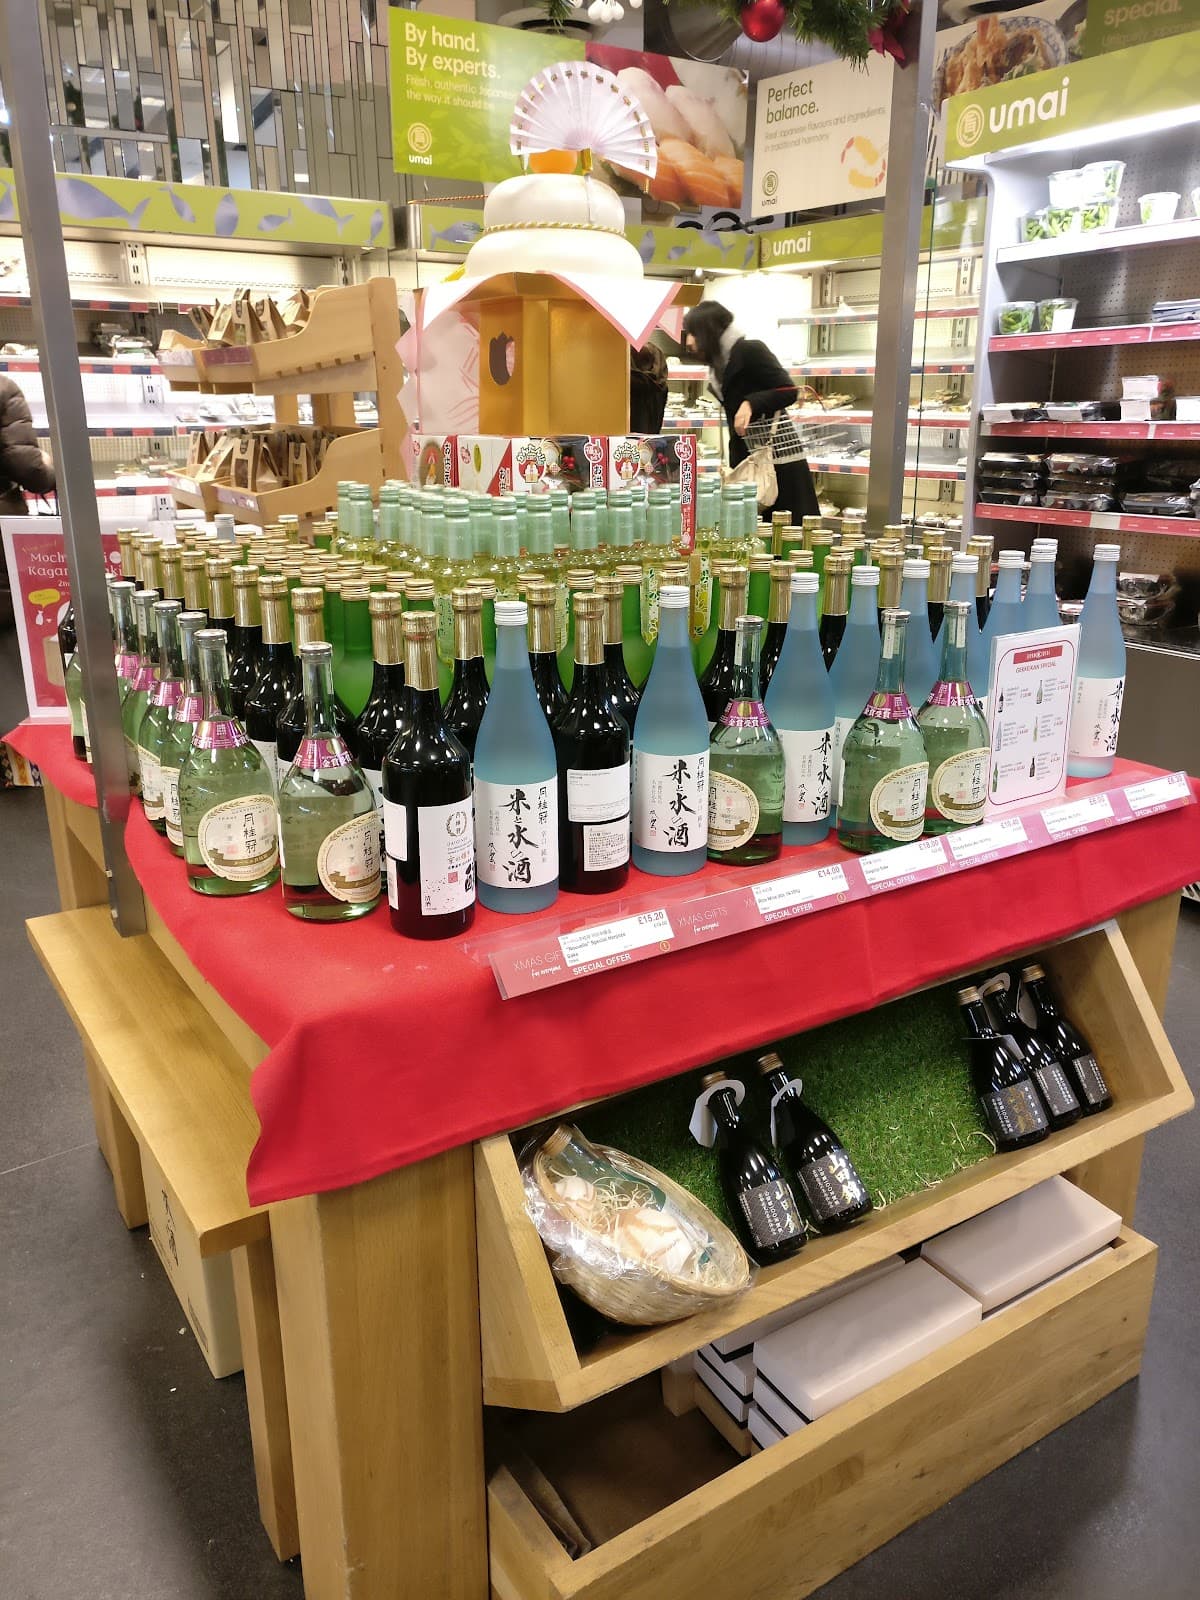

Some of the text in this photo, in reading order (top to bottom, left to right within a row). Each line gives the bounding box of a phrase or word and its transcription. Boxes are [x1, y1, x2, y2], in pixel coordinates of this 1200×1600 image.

[405, 22, 480, 53] By hand.
[405, 46, 501, 79] By experts.
[435, 78, 477, 94] authentic
[767, 80, 814, 104] Perfect
[406, 89, 421, 101] the
[423, 93, 442, 105] way
[443, 95, 450, 105] it
[988, 76, 1070, 134] umai
[766, 101, 819, 125] balance.
[408, 152, 433, 166] umai
[761, 196, 778, 207] umai
[773, 231, 811, 257] umai
[663, 759, 697, 848] 米と水の酒
[243, 812, 257, 854] 月桂冠
[498, 788, 540, 884] 米と水の酒
[918, 839, 939, 851] £18.00
[817, 866, 841, 878] £14.00
[637, 911, 665, 925] £15.20
[677, 907, 728, 926] XMAS GIFTS
[763, 903, 814, 922] SPECIAL OFFER
[512, 956, 543, 971] XMAS
[572, 953, 632, 976] SPECIAL OFFER
